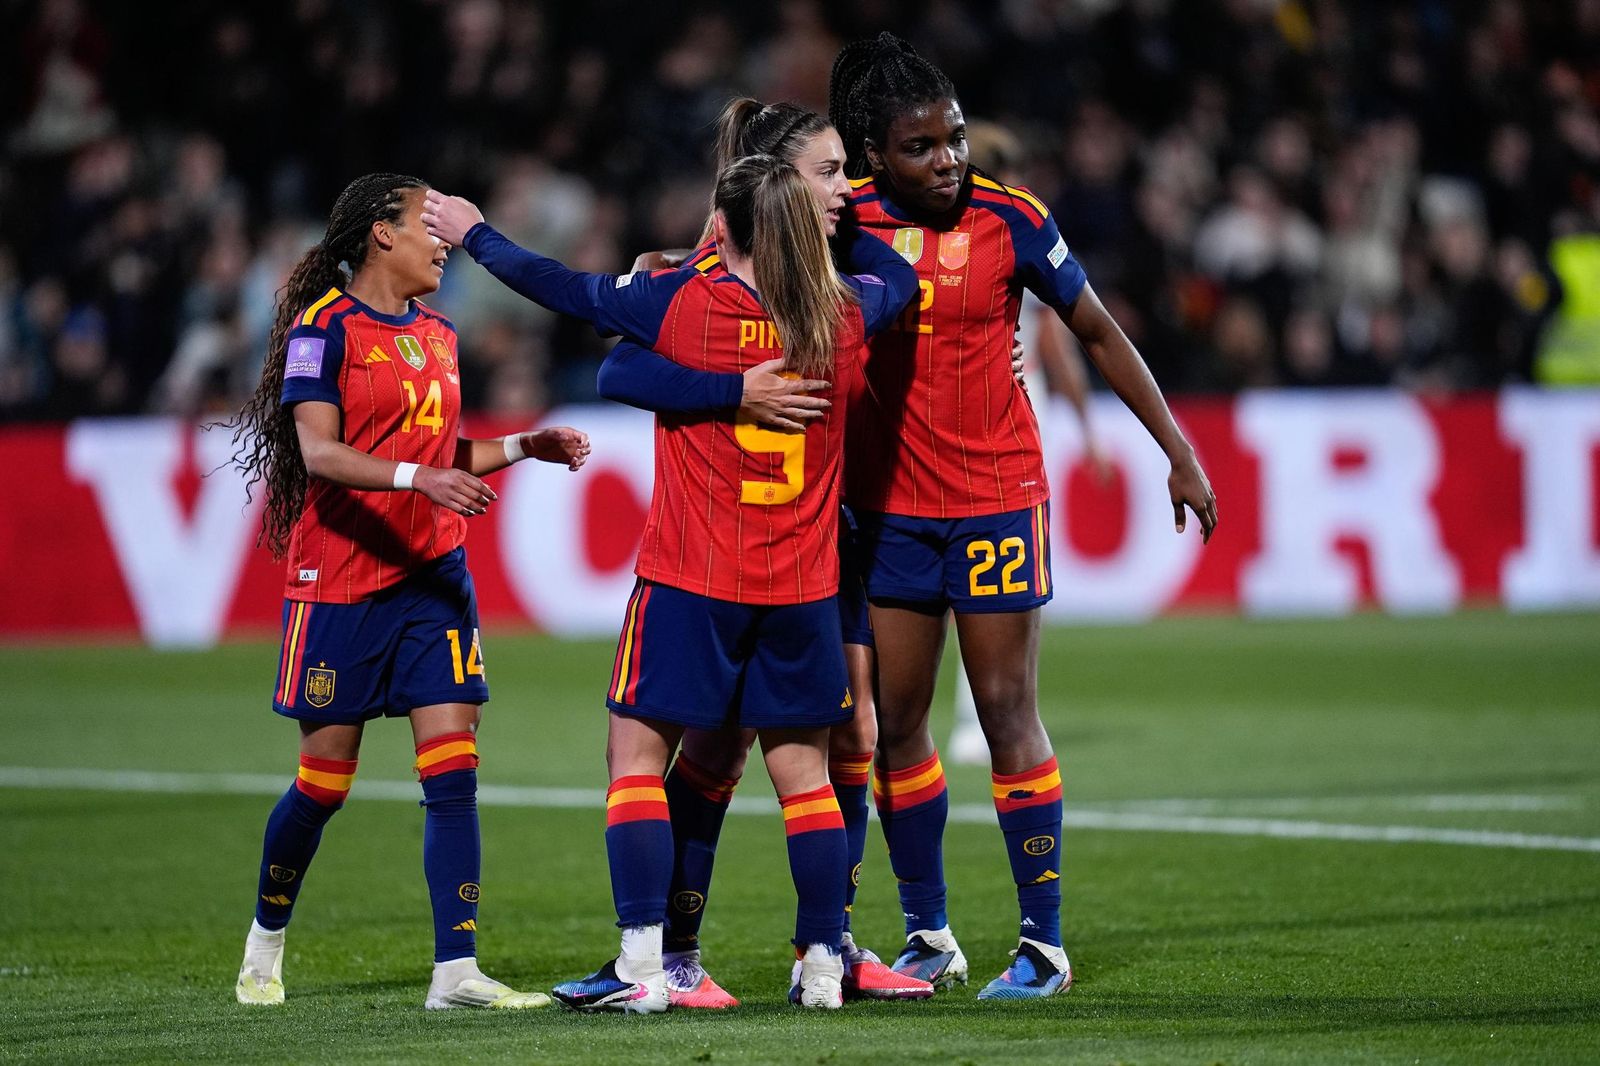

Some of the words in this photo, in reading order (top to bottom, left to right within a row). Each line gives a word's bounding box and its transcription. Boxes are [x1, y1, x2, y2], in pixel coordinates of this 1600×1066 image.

[739, 319, 784, 349] PIN
[401, 379, 444, 436] 14
[966, 536, 1028, 597] 22
[446, 627, 485, 684] 14
